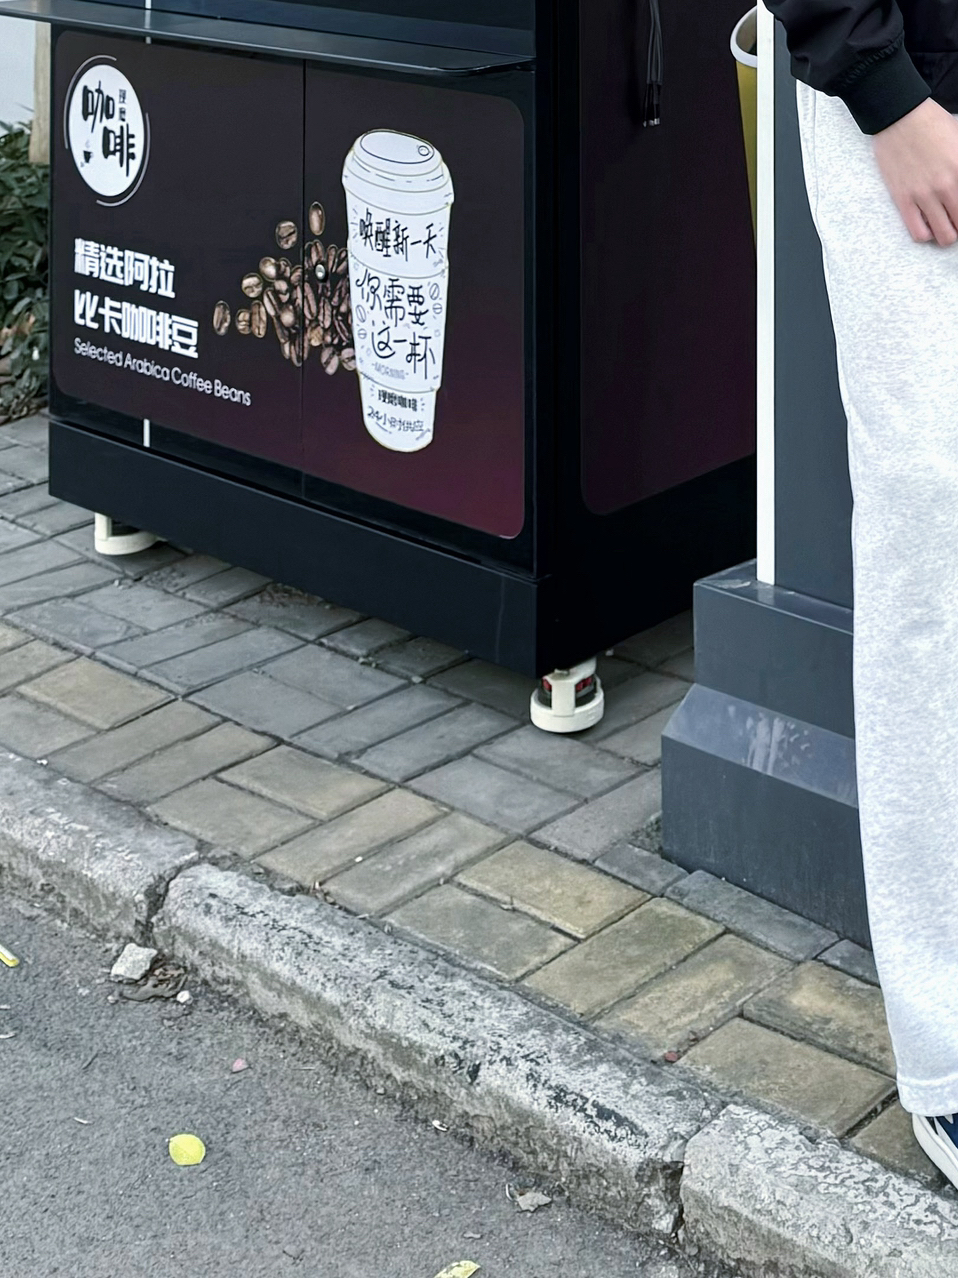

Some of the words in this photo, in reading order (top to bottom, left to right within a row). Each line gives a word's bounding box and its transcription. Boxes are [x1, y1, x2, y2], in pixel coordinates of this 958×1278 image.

[359, 207, 438, 262] 唤醒新一天
[74, 238, 176, 299] 精选阿拉
[355, 269, 429, 327] 你需要
[74, 289, 199, 359] 比卡咖啡豆
[371, 320, 436, 380] 这一杯
[74, 337, 124, 367] Selected
[123, 353, 170, 382] Arabica
[171, 367, 213, 394] Coffee
[214, 379, 252, 406] Beans
